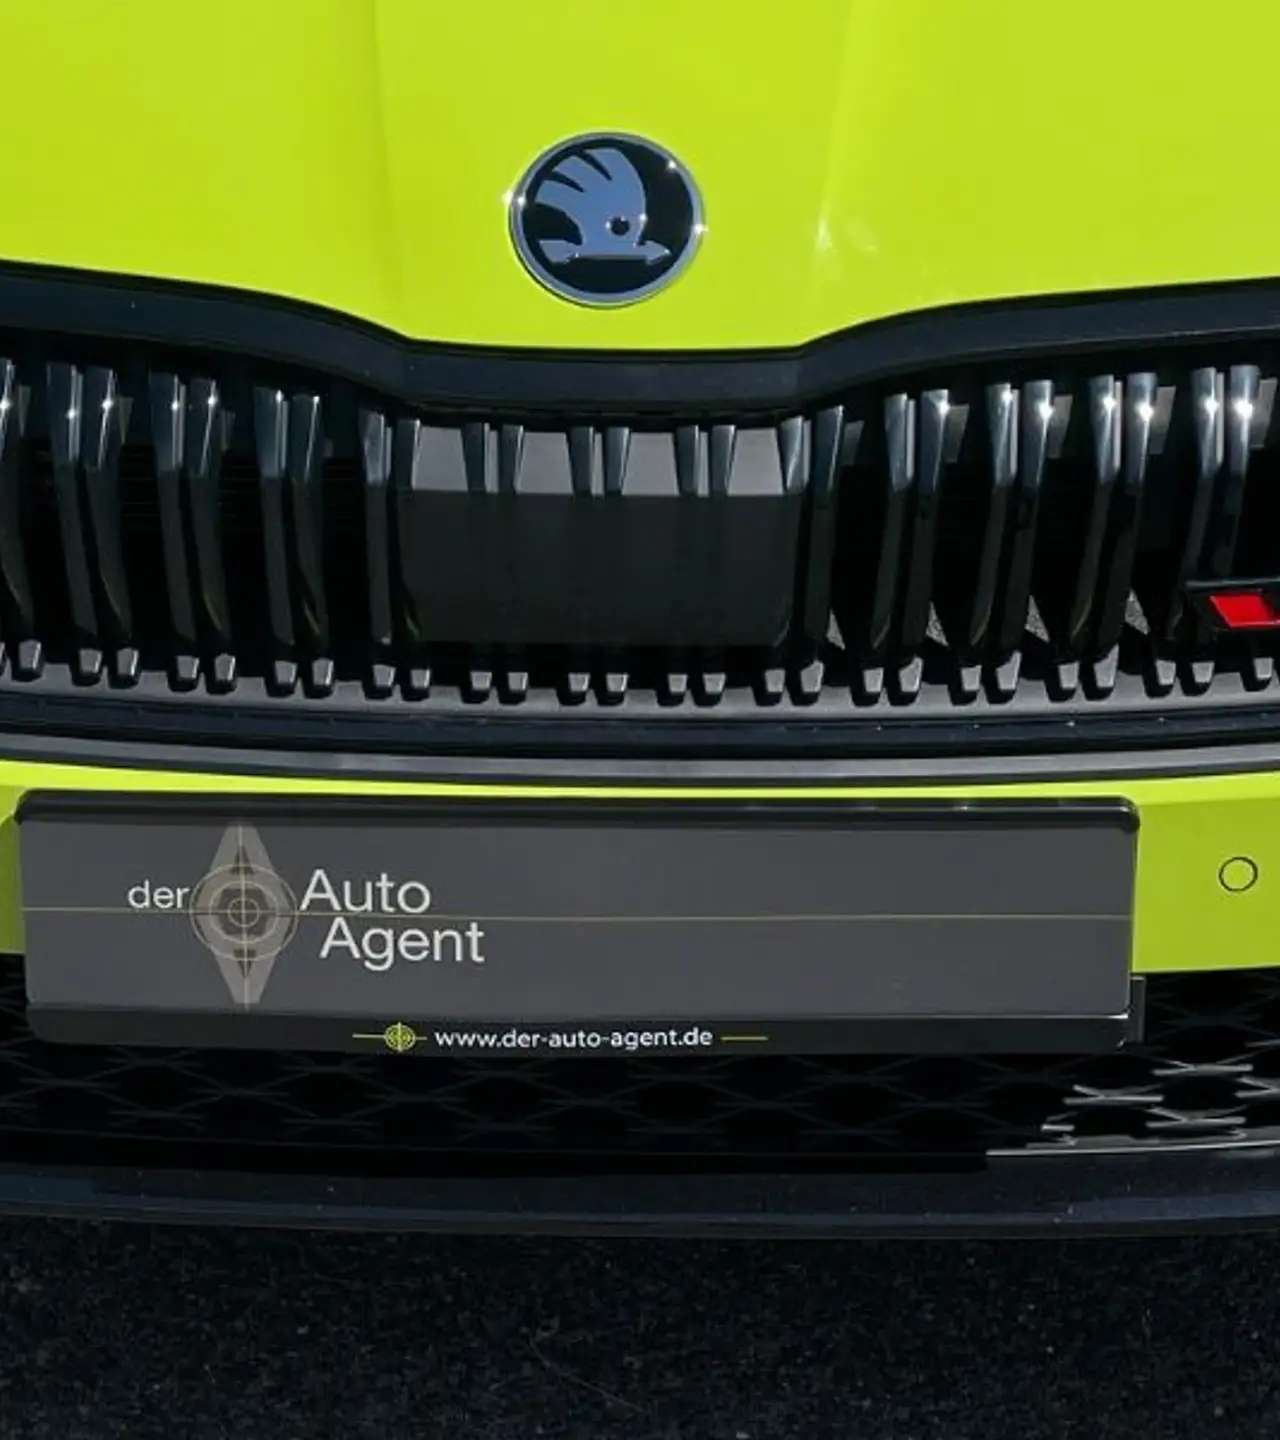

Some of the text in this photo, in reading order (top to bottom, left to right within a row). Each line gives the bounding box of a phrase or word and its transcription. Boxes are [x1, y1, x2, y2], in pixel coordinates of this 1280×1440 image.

[127, 868, 431, 914] der Auto
[319, 916, 486, 972] Agent
[433, 1026, 714, 1051] www.der-auto-agent.de
